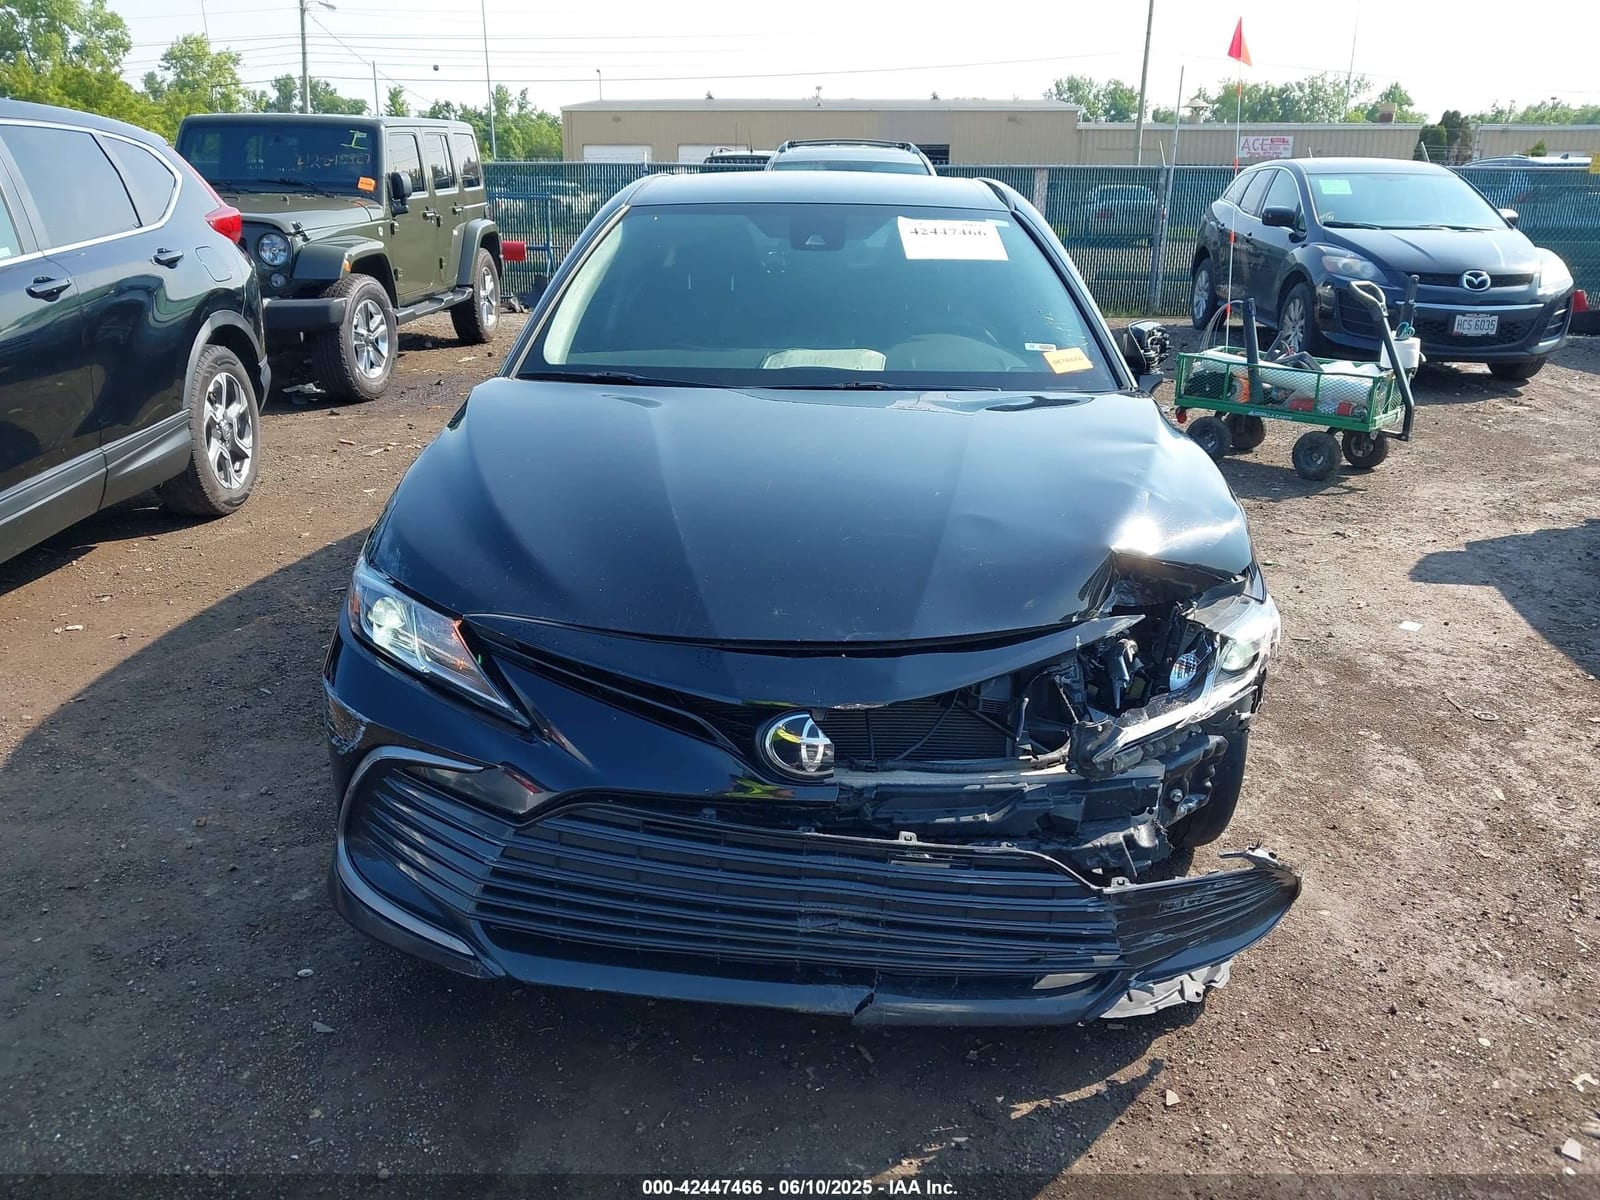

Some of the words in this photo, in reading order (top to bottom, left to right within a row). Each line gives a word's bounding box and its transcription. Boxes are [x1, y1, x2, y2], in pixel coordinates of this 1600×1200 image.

[1241, 138, 1268, 151] ACE
[910, 227, 987, 237] 42447466
[1457, 319, 1473, 331] HCS
[1474, 319, 1497, 331] 6035
